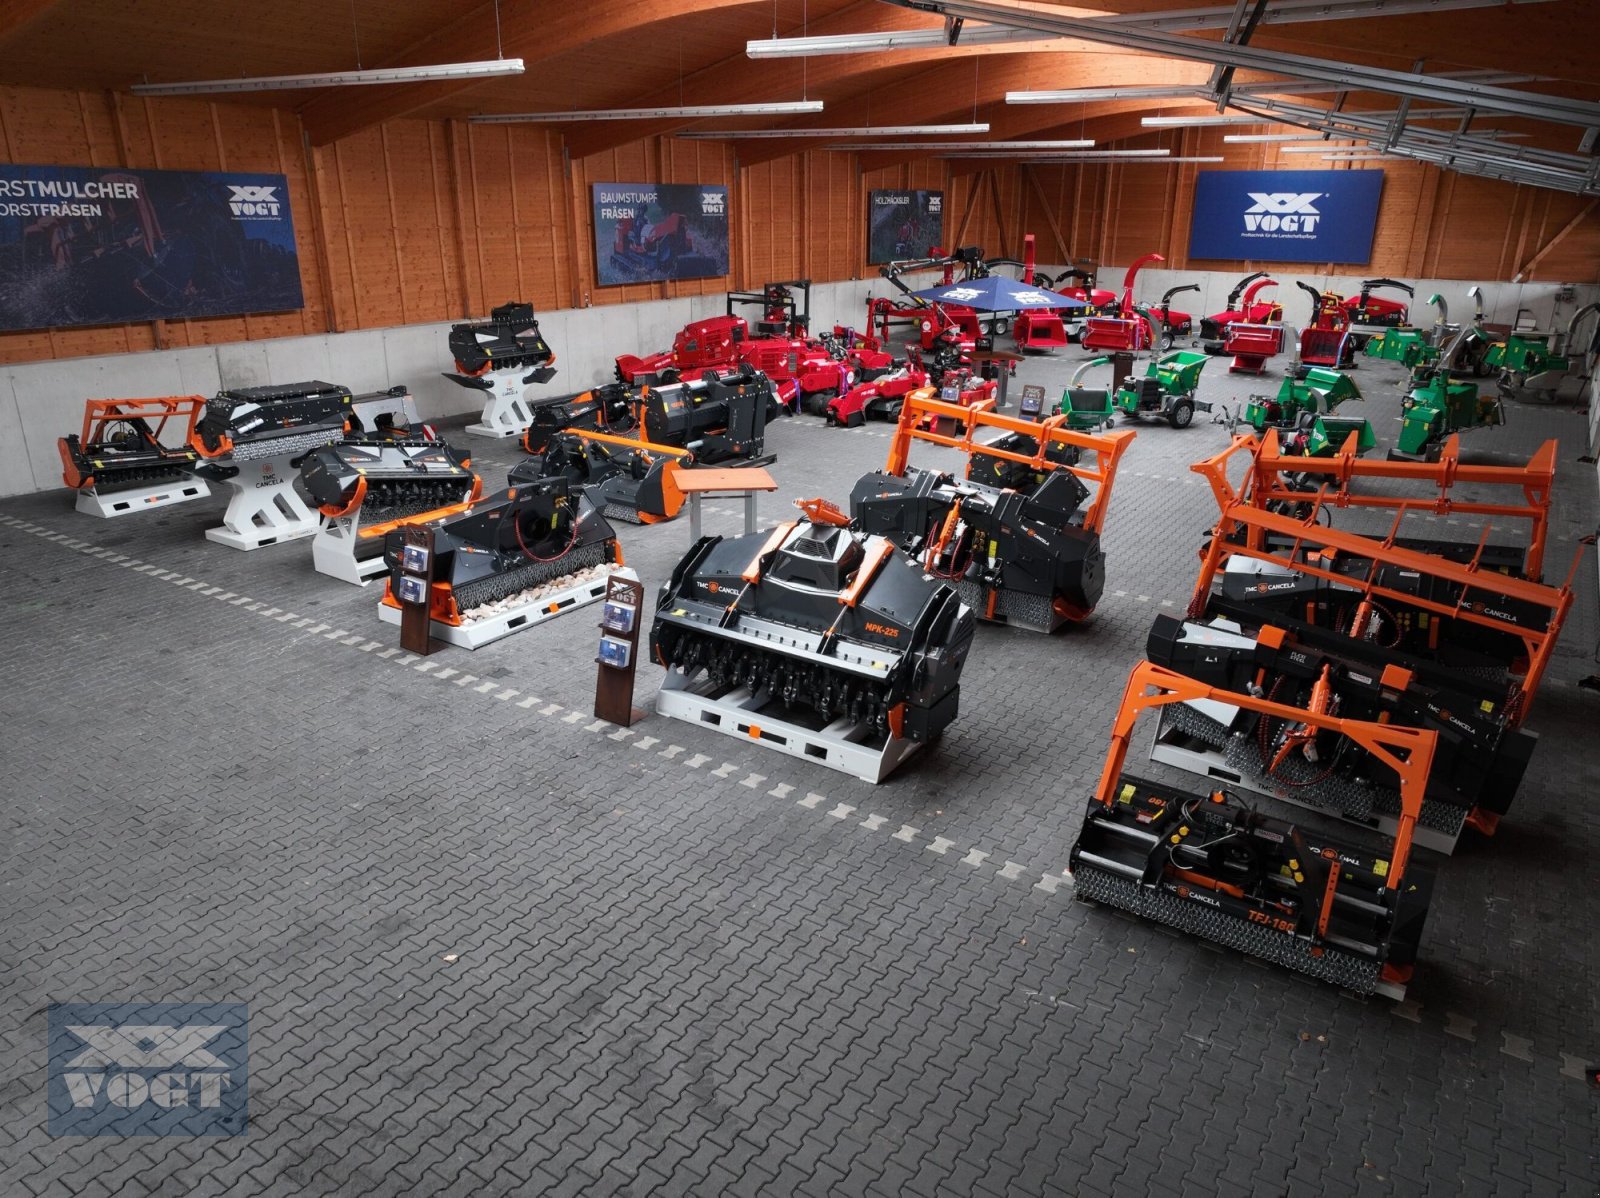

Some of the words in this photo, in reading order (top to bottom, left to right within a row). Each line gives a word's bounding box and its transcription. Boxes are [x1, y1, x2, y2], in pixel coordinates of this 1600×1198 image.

[0, 179, 140, 199] RSTMULCHER
[600, 191, 659, 204] BAUMSTUMPF
[228, 202, 281, 216] VOGT
[601, 206, 635, 219] FRÄSEN
[702, 204, 725, 213] VOGT
[1243, 215, 1320, 233] VOGT
[255, 478, 284, 489] CANCELA
[697, 581, 709, 589] TMC
[718, 586, 744, 597] CANCEL
[1267, 582, 1296, 591] CANCELA
[1484, 607, 1517, 622] CANCELA
[865, 622, 899, 637] MPK-225
[1427, 703, 1440, 713] TMC
[1449, 716, 1476, 734] CANCELA
[1189, 891, 1220, 907] CANCELA
[1248, 909, 1297, 931] TFJ-180
